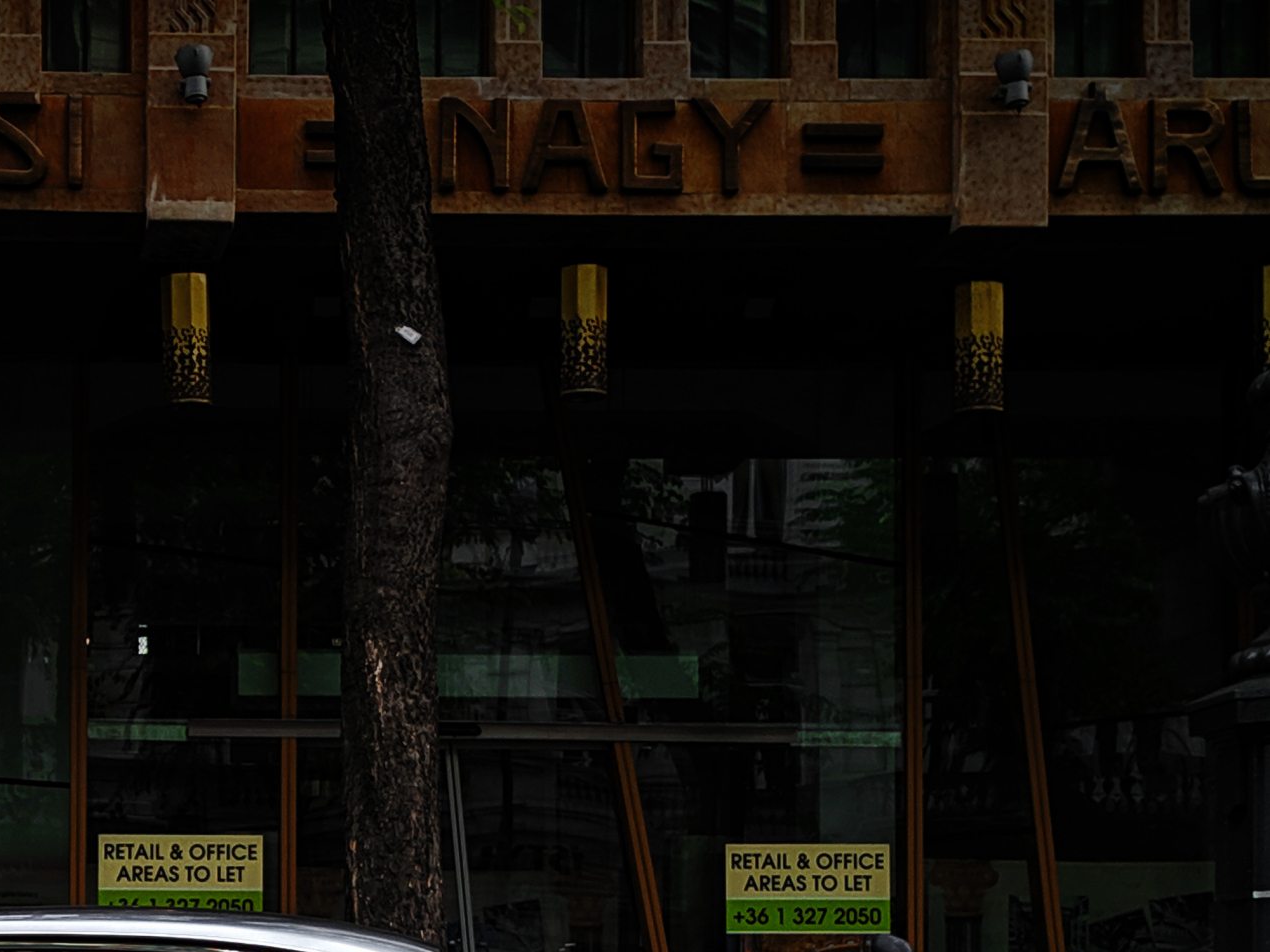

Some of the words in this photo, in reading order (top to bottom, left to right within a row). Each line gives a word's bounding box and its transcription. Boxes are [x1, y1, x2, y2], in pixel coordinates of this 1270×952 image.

[104, 843, 164, 861] RETAIL
[170, 843, 184, 861] &
[189, 843, 258, 861] OFFICE
[731, 853, 791, 870] RETAIL
[796, 853, 810, 870] &
[816, 853, 884, 870] OFFICE
[116, 865, 179, 882] AREAS
[186, 865, 210, 882] TO
[217, 865, 245, 882] LET
[744, 875, 807, 892] AREAS
[813, 875, 837, 892] TO
[844, 875, 872, 892] LET
[733, 908, 769, 925] +36
[777, 908, 785, 925] 1
[792, 908, 827, 925] 327
[834, 908, 882, 925] 2050
